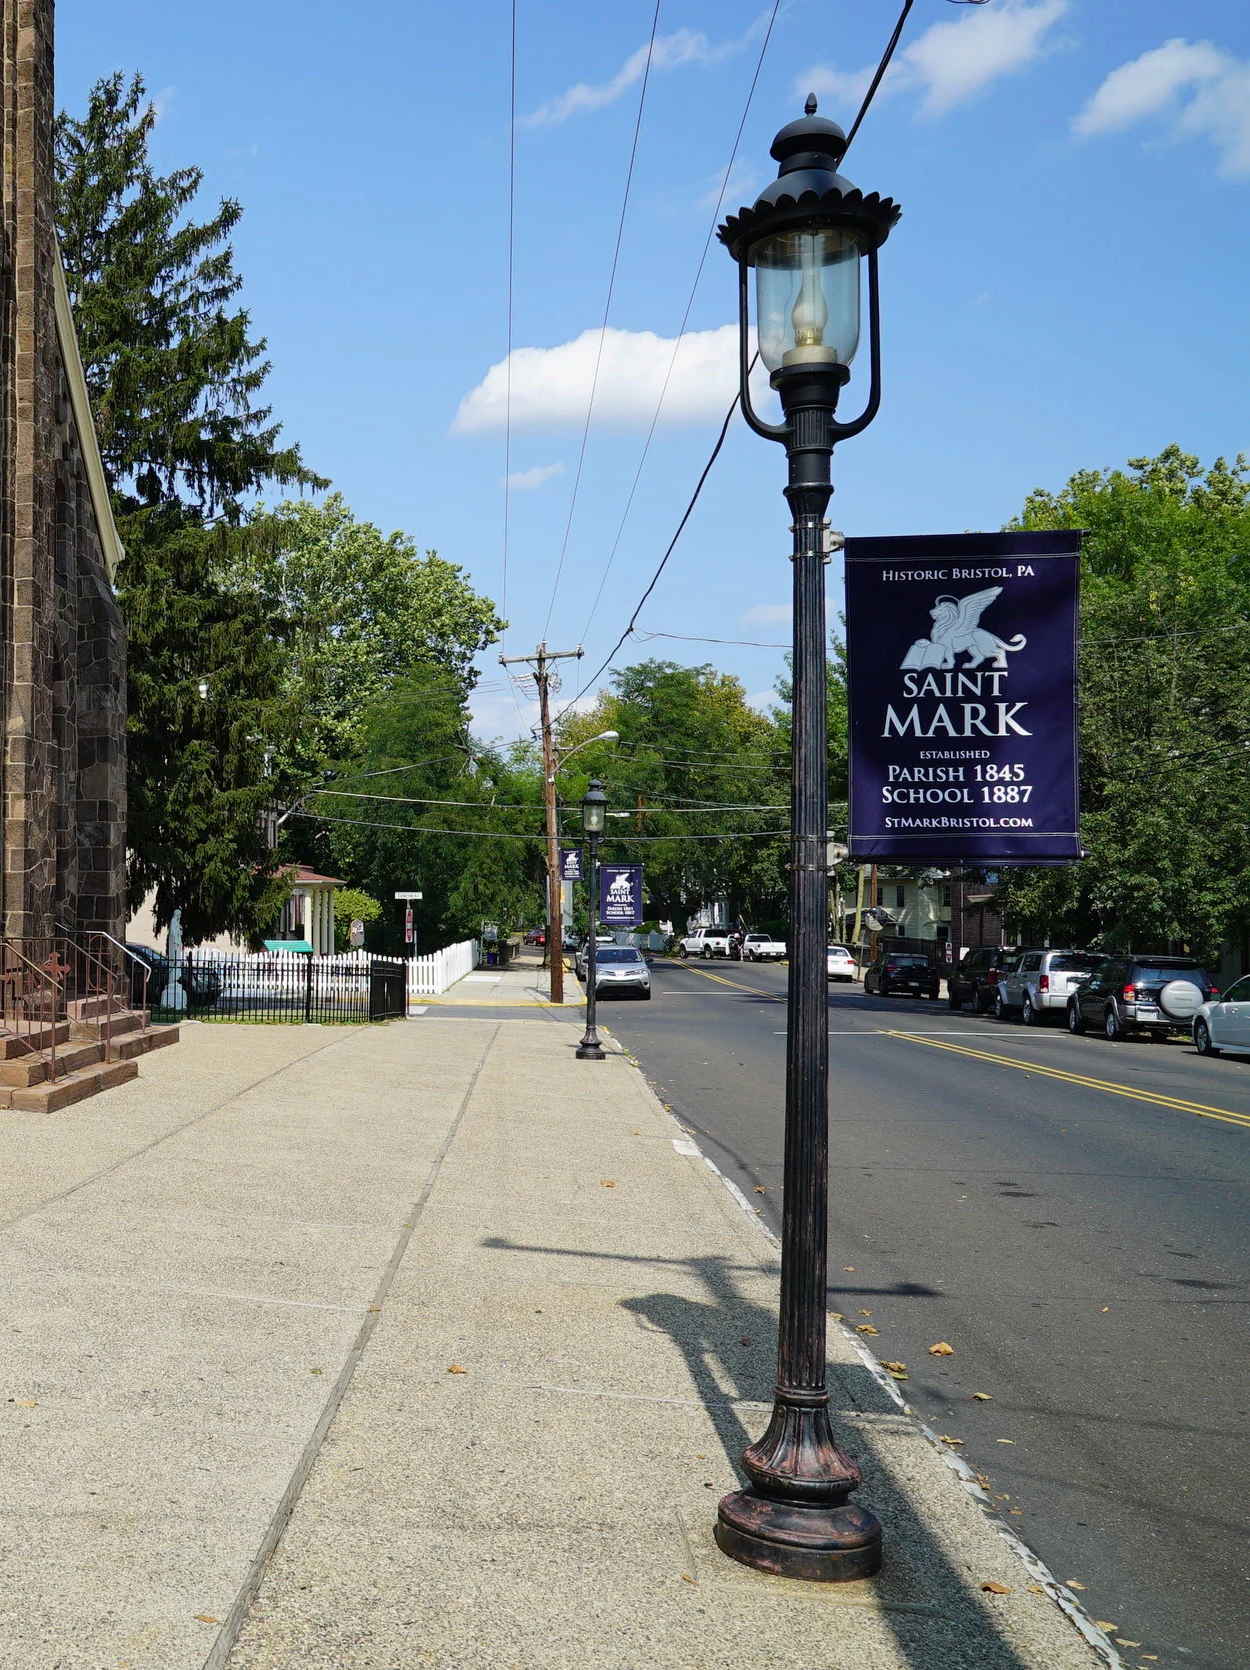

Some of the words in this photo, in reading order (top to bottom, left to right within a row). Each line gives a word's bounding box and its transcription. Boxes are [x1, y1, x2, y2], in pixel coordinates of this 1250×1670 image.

[882, 569, 948, 581] HISTORIC
[1017, 565, 1035, 577] PA
[903, 671, 1008, 698] SAINT
[881, 702, 1033, 738] MARK
[920, 750, 990, 759] ESTABLISHED
[888, 765, 965, 782] PARISH
[973, 764, 1025, 781] 1845
[882, 786, 974, 804] SCHOOL
[981, 785, 1033, 803] 1887
